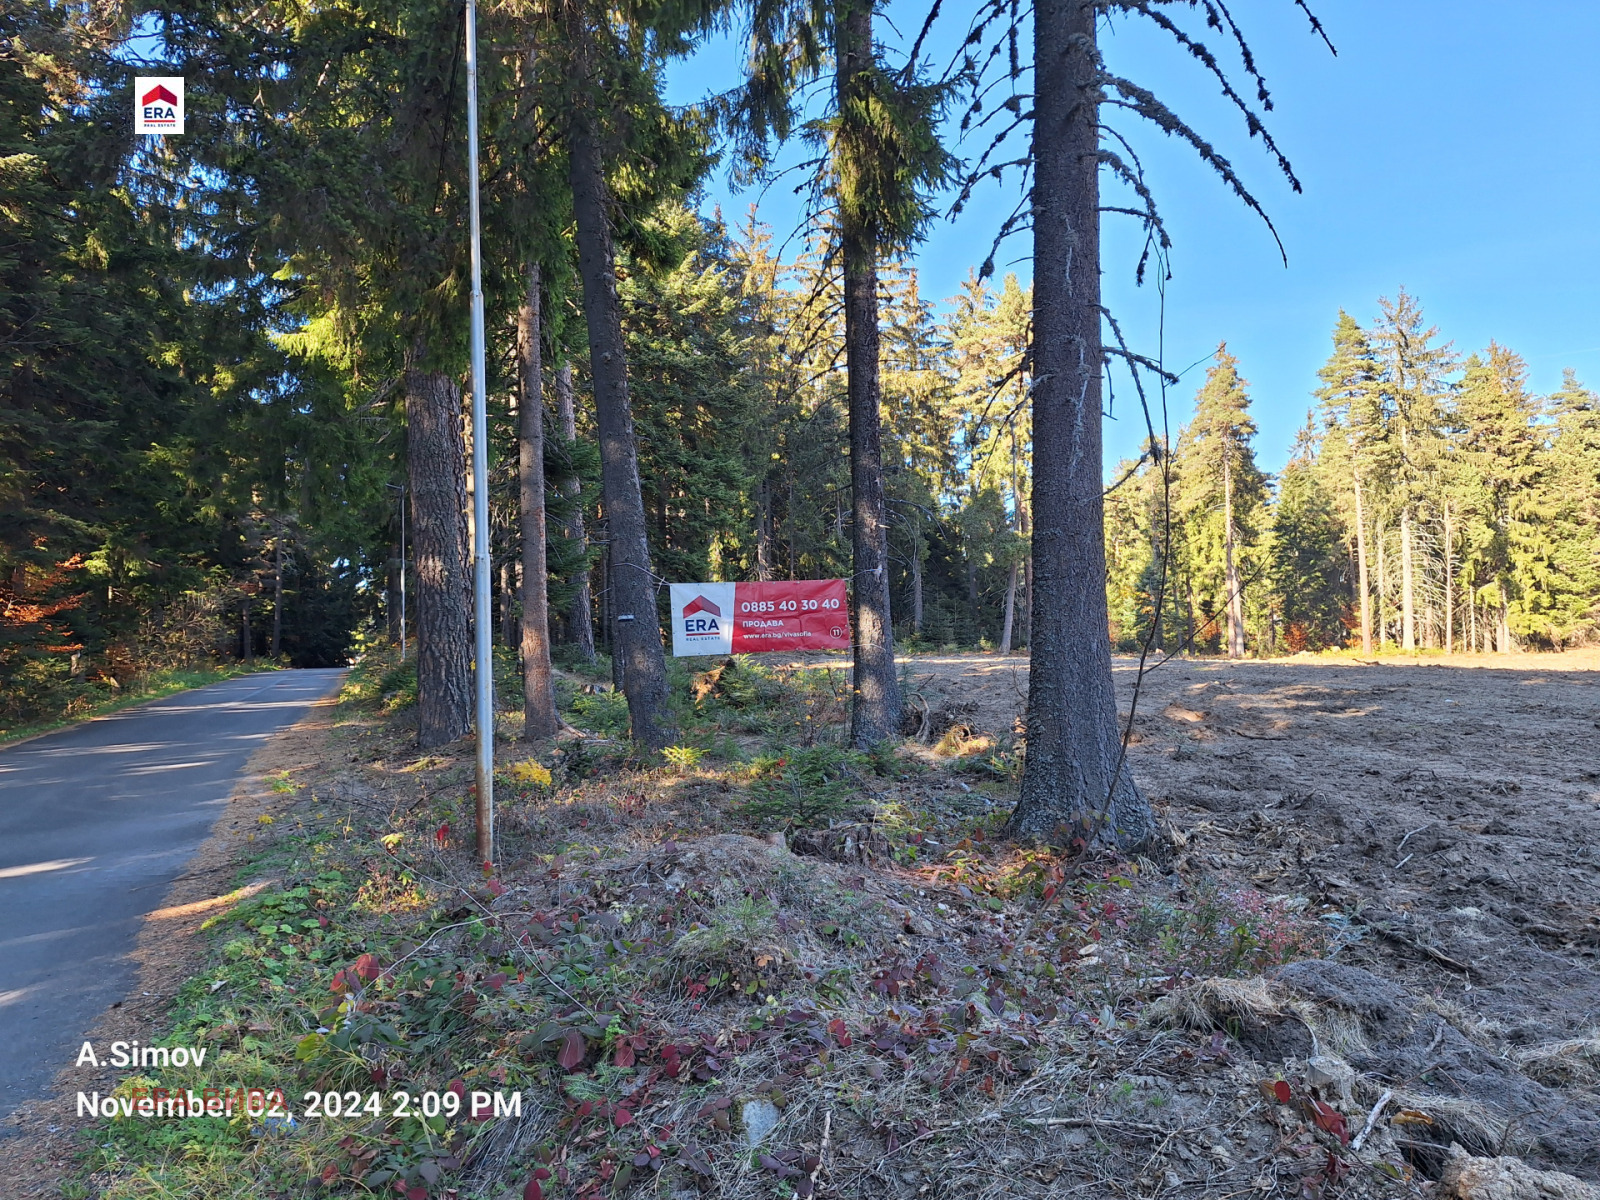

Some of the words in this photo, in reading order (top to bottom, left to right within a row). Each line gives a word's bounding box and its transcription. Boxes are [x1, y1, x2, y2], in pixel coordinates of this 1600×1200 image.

[741, 601, 775, 613] 0885
[779, 600, 797, 611] 40
[801, 599, 818, 610] 30
[822, 598, 840, 609] 40
[685, 618, 720, 632] ERA
[742, 620, 784, 628] ПРОДАВА
[743, 631, 812, 639] www.era.bg/vivasofia
